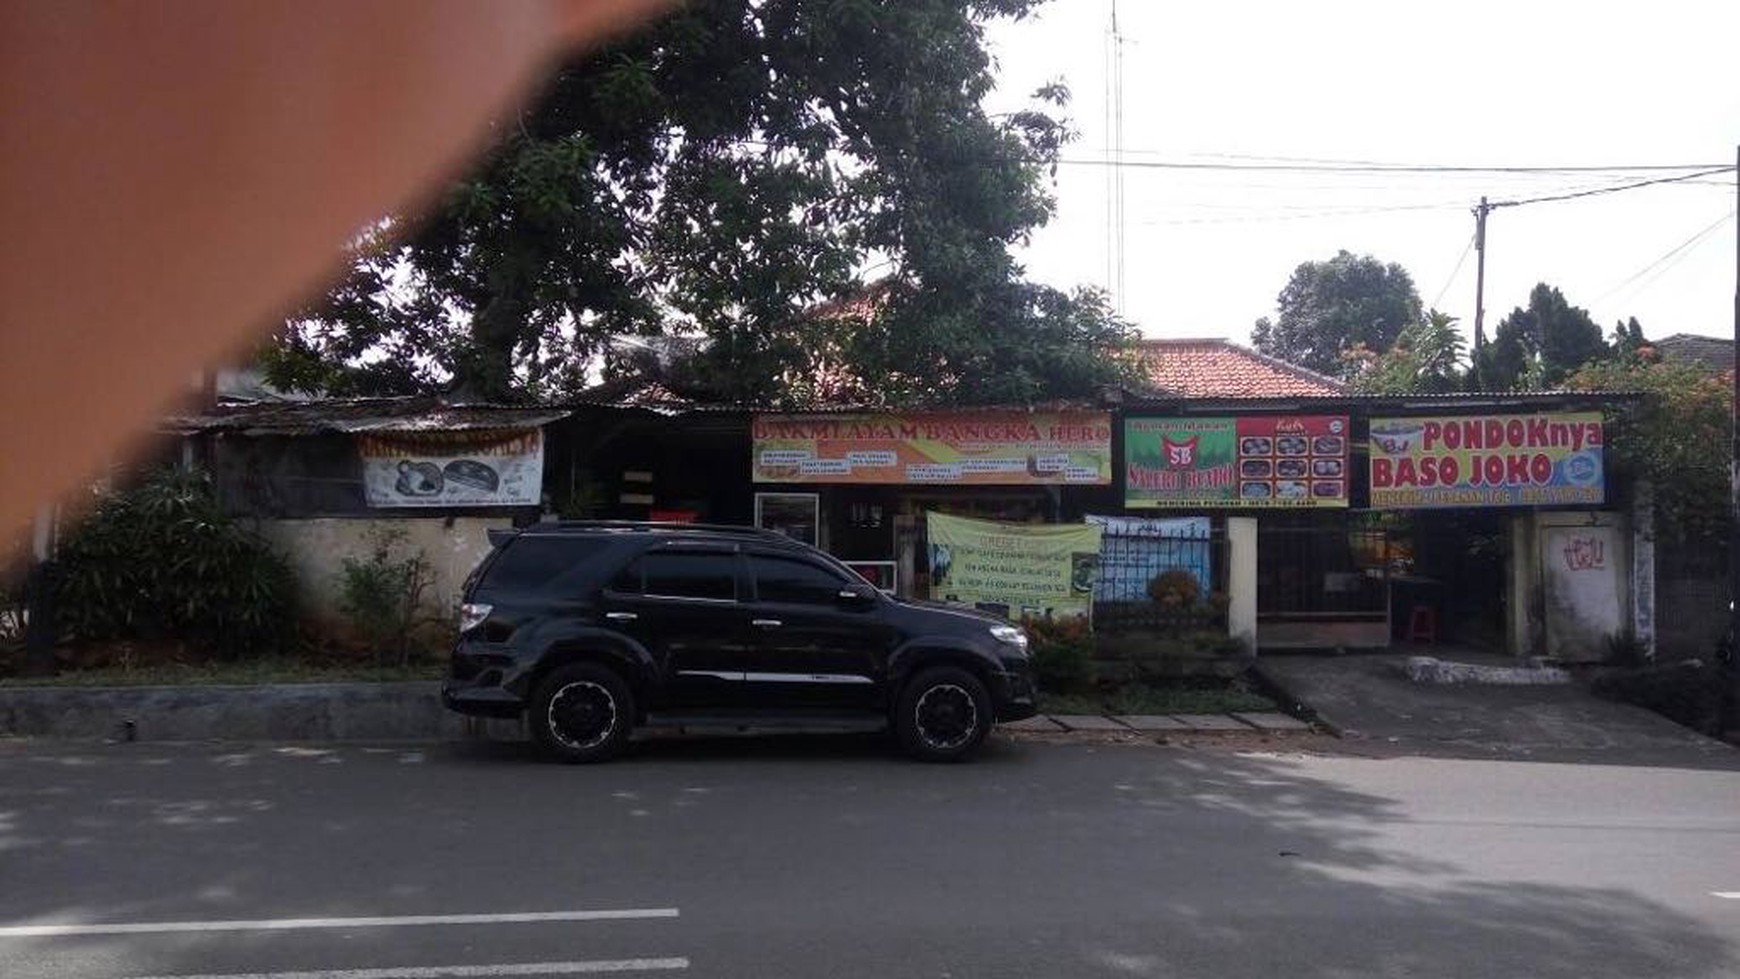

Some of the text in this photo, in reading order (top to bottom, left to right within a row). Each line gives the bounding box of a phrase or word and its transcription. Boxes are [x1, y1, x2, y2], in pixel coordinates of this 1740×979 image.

[850, 422, 918, 440] AYAM
[925, 423, 1042, 441] BANGKA
[1422, 418, 1602, 452] PONDOKnya
[1170, 446, 1192, 465] SB
[1372, 455, 1460, 488] BASO
[1467, 452, 1553, 486] JOKO
